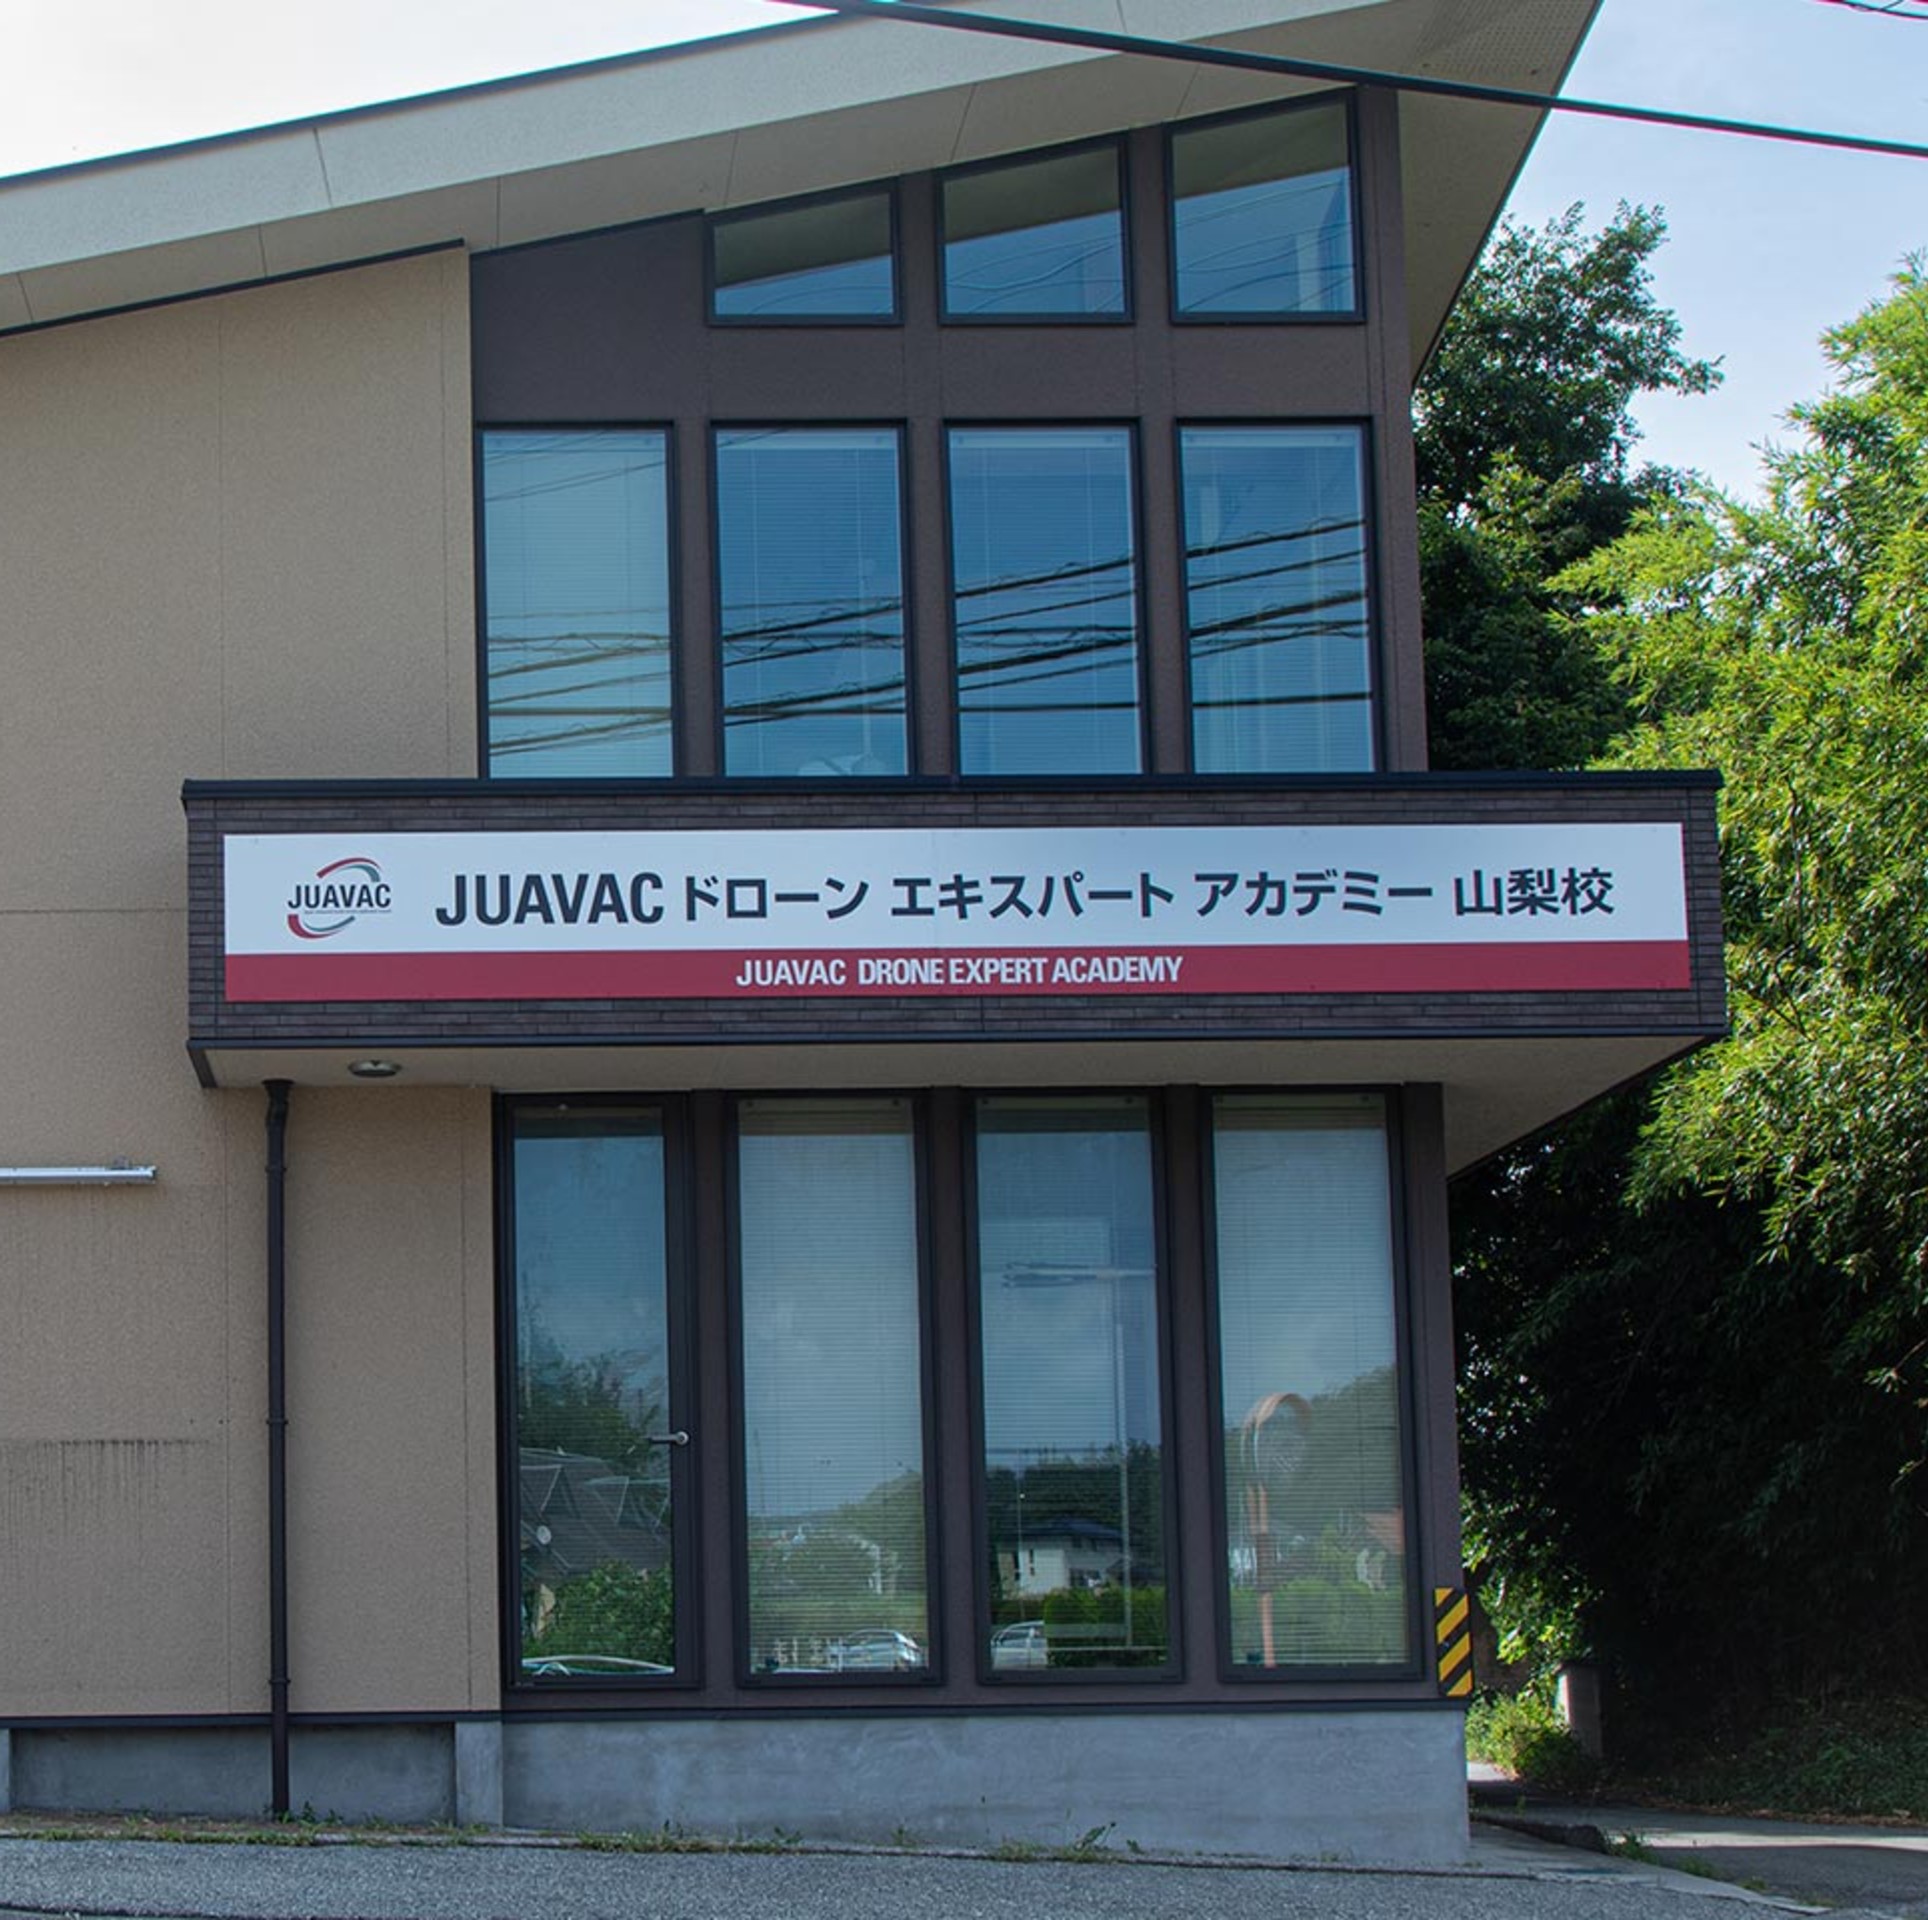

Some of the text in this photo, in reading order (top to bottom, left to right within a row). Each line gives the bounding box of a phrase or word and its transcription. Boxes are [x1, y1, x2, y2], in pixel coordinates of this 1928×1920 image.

[287, 883, 392, 909] JUAVAC
[435, 866, 1614, 926] JUAVAC ドローン エキスパート アカデミー 山梨校
[736, 955, 1183, 987] JUAVAC DRONE EXPERT ACADEMY
